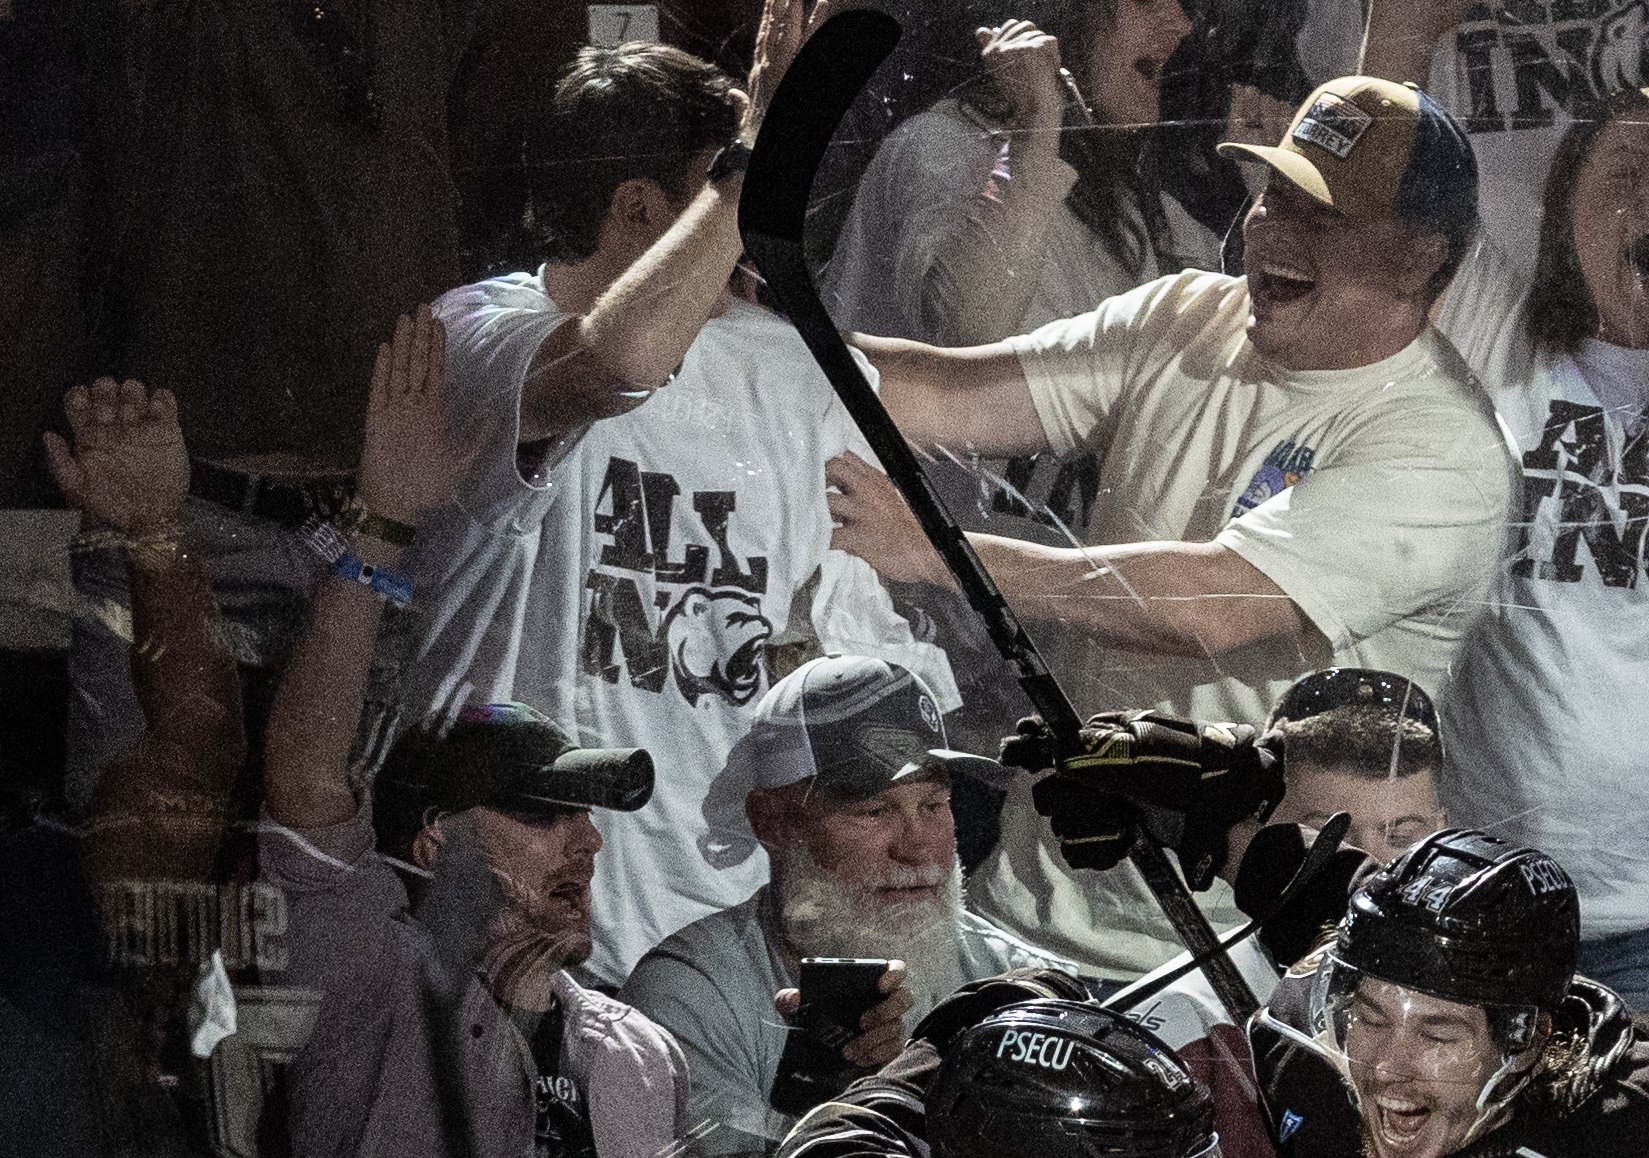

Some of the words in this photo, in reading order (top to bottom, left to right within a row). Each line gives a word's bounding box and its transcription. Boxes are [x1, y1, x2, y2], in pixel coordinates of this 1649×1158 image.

[615, 11, 632, 41] 7
[592, 456, 767, 594] ALL
[1400, 873, 1454, 914] 44
[996, 1029, 1076, 1071] PSECU
